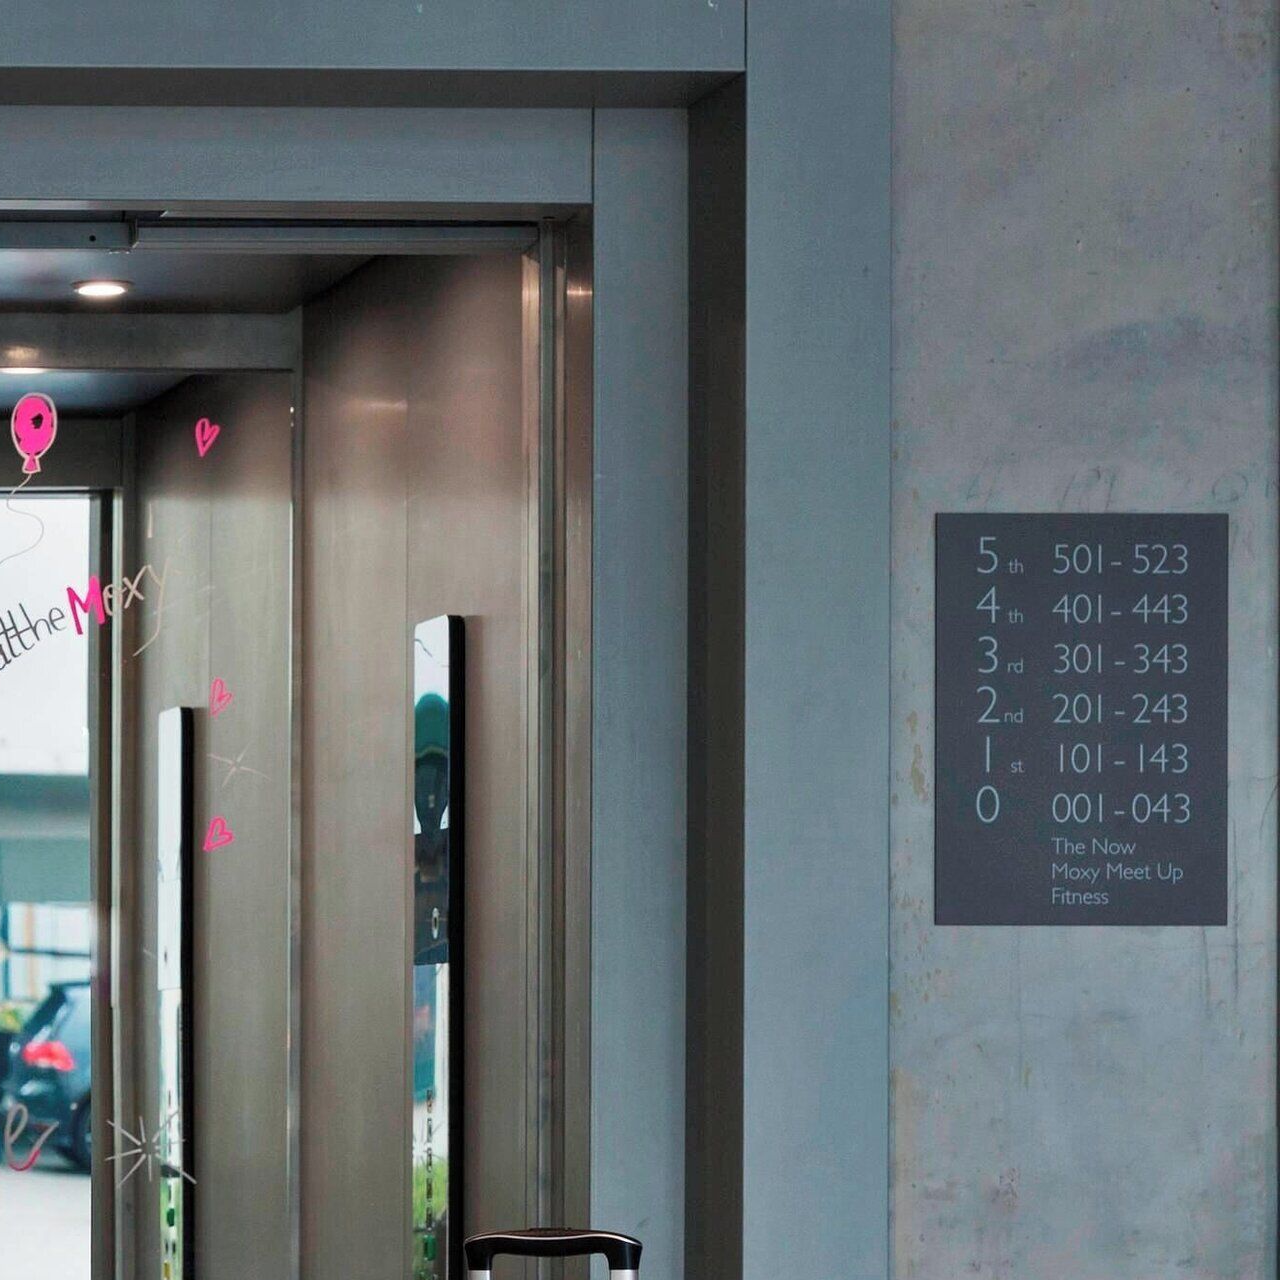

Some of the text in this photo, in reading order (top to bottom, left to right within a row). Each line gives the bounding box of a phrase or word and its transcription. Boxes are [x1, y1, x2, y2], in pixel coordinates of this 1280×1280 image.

[1051, 837, 1136, 855] The Now
[1051, 864, 1184, 883] Moxy Meet Up
[1051, 888, 1110, 905] Fitness
